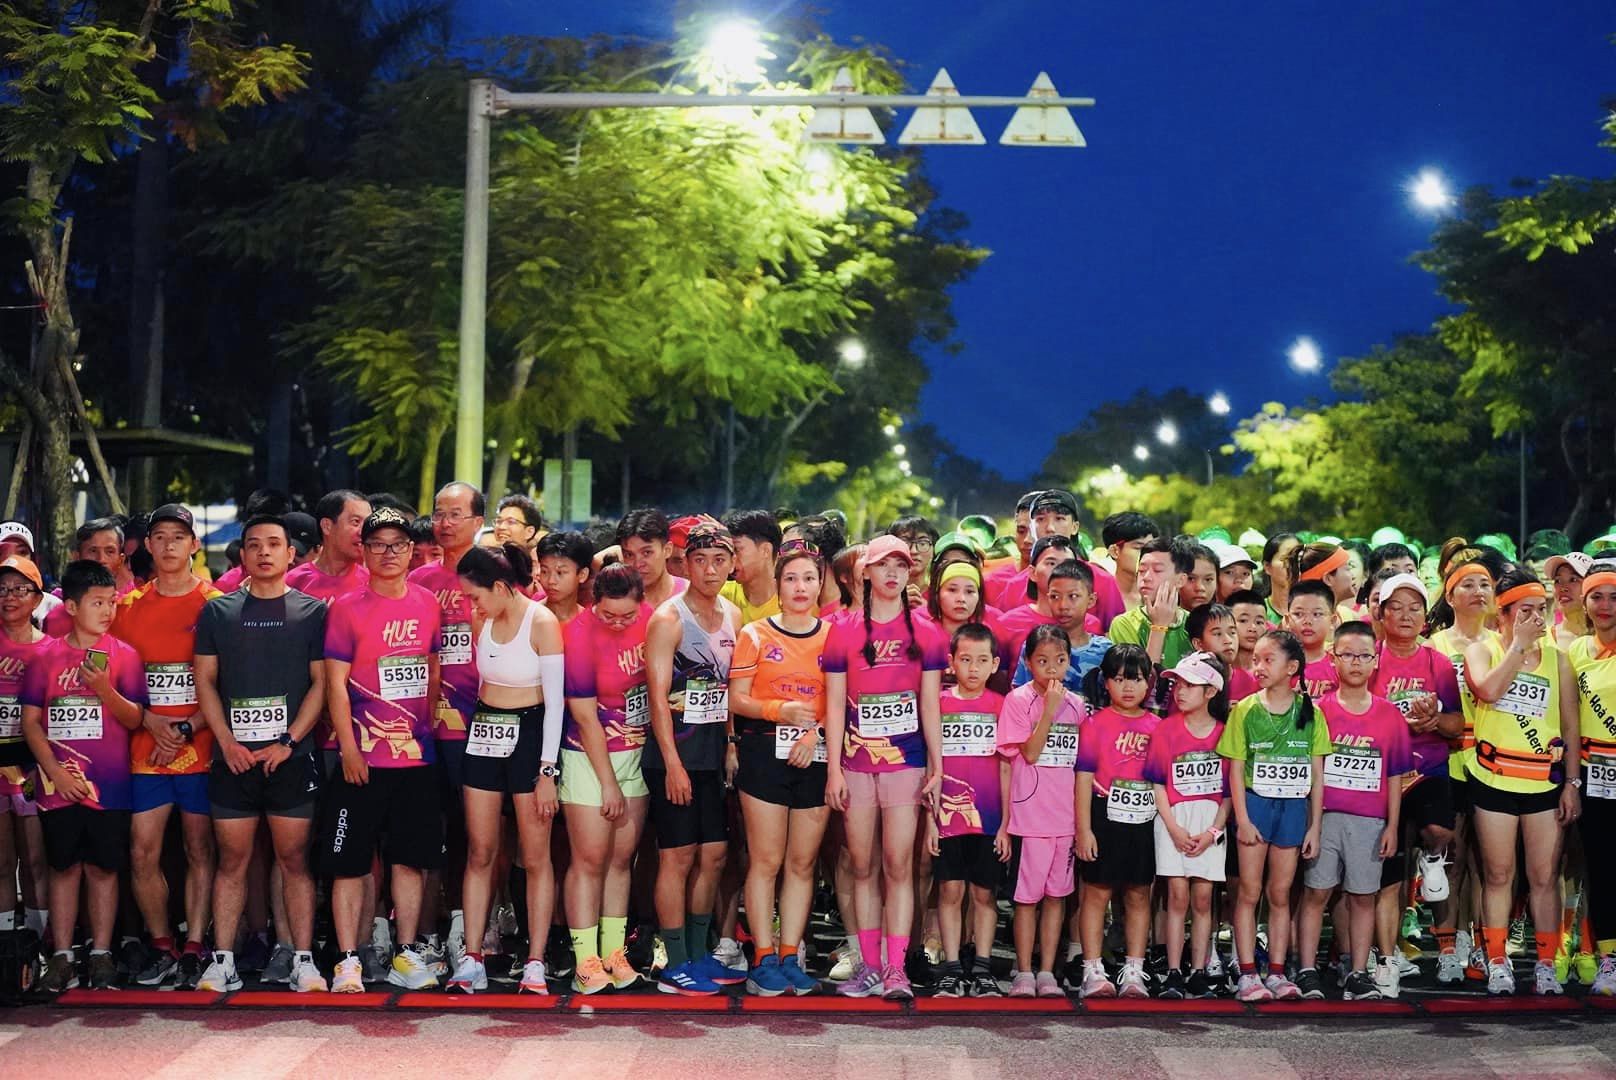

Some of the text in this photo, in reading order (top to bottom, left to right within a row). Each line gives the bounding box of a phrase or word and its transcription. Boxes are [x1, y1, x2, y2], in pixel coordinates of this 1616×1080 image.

[382, 619, 419, 648] HUE
[147, 673, 195, 688] 52748
[384, 666, 426, 682] 55312
[1507, 681, 1546, 701] 2931
[50, 708, 99, 722] 52924
[233, 708, 284, 723] 53298
[862, 702, 914, 719] 52534
[473, 724, 515, 740] 55134
[943, 724, 994, 738] 52502
[1046, 735, 1076, 749] 5462
[1115, 731, 1150, 755] HUE
[1176, 761, 1220, 778] 54027
[1334, 756, 1376, 771] 57274
[1257, 765, 1308, 780] 53394
[1111, 789, 1155, 806] 56390
[333, 808, 348, 853] adidas
